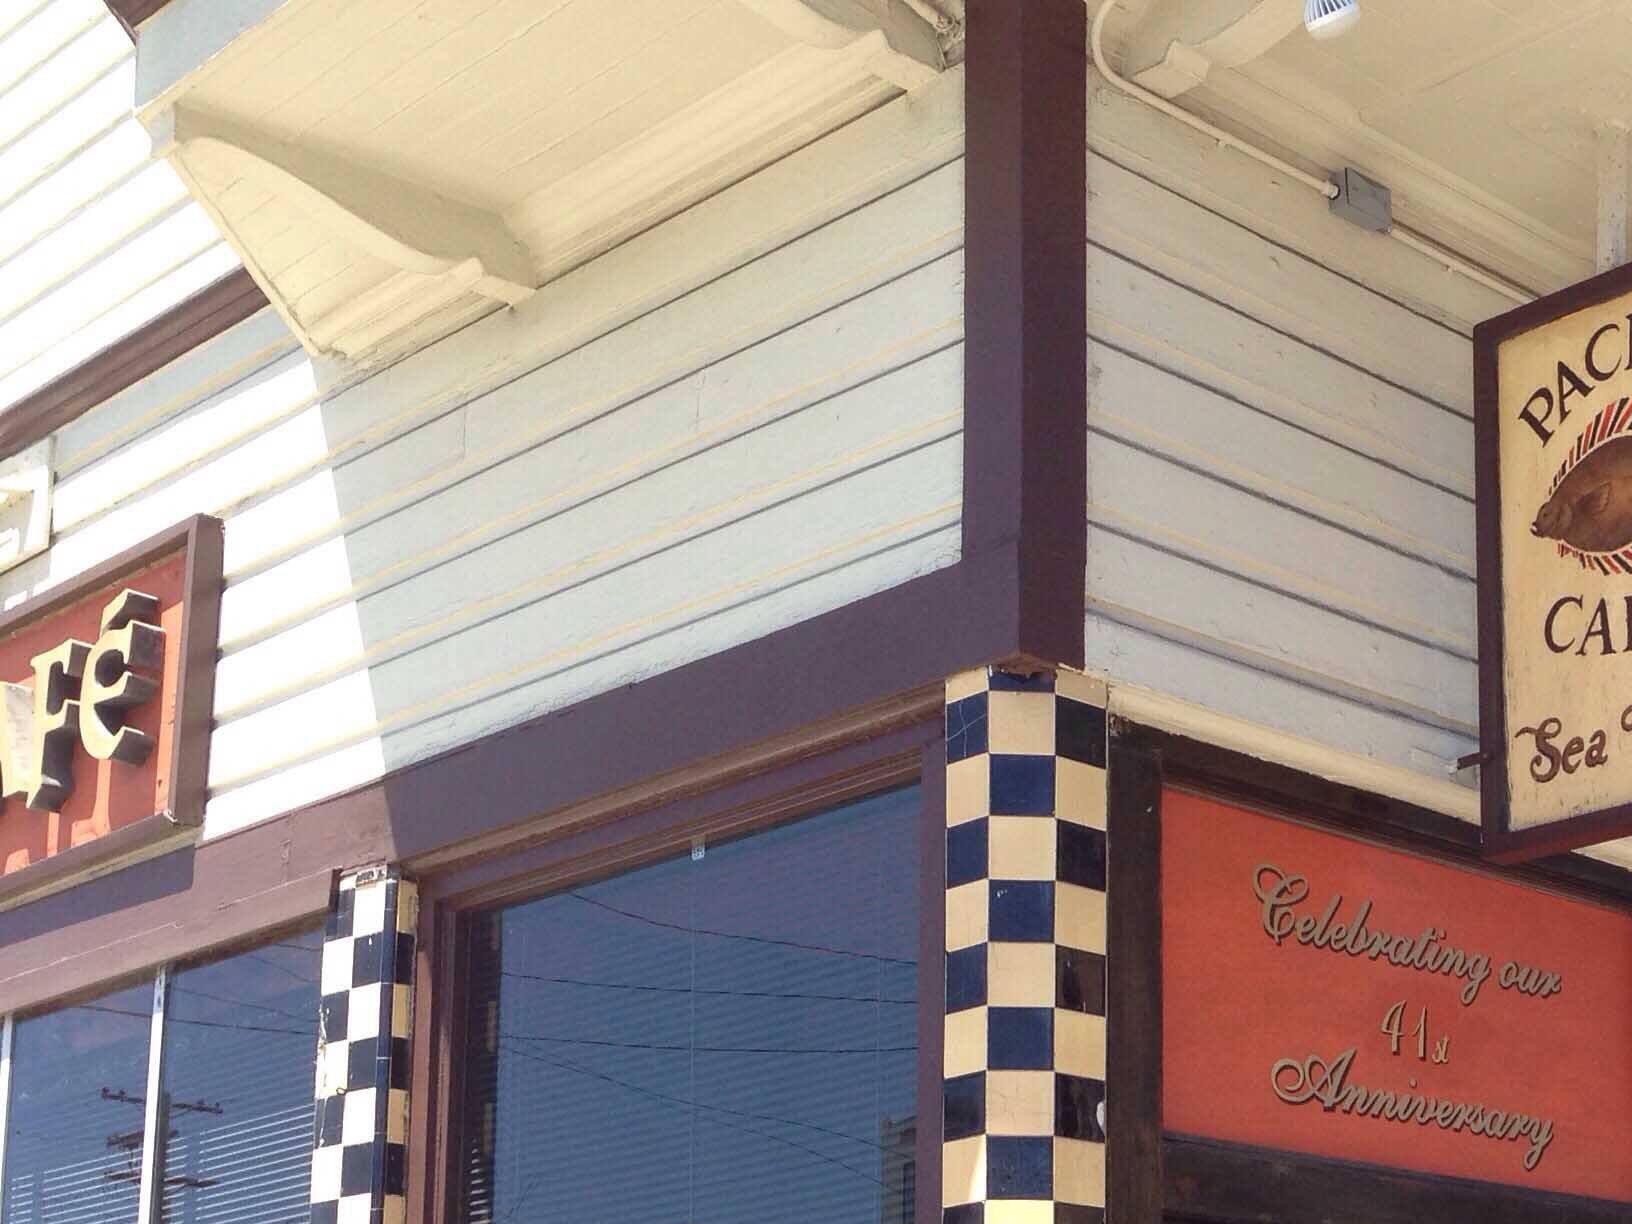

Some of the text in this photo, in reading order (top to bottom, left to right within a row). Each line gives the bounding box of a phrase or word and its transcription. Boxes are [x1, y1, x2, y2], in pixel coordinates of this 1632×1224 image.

[1514, 716, 1608, 785] Sea
[1251, 863, 1562, 1006] Celebrating our
[1379, 999, 1450, 1064] 41st
[1270, 1047, 1554, 1169] Anniversary
